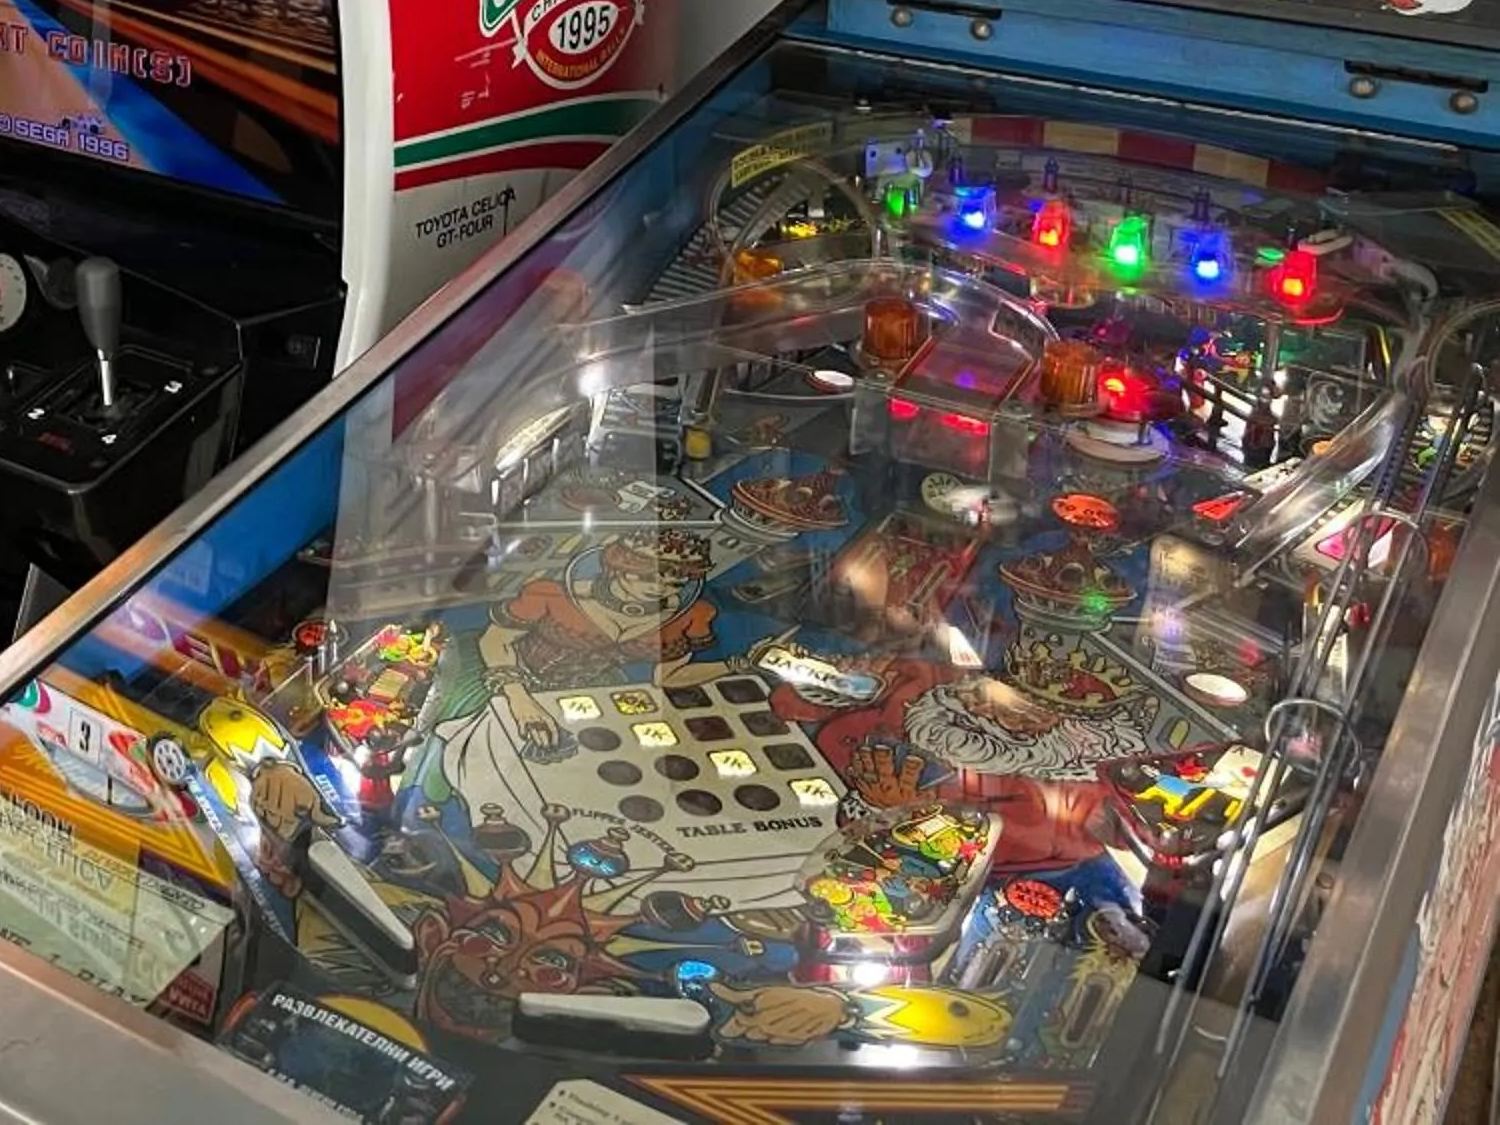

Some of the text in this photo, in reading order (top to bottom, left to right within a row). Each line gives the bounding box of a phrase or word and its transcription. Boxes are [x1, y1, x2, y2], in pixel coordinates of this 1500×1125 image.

[557, 5, 612, 51] 1995
[47, 30, 192, 88] COIN(S)
[14, 119, 70, 148] SEGA
[77, 134, 131, 162] 1996
[415, 186, 517, 239] TOYOTA CELICA
[436, 214, 494, 249] GT-FOUR
[675, 814, 824, 839] TABLE BONUS
[271, 993, 410, 1063] РАЗВЛЕКАТЕЛНИ
[407, 1055, 456, 1092] ИГРИ
